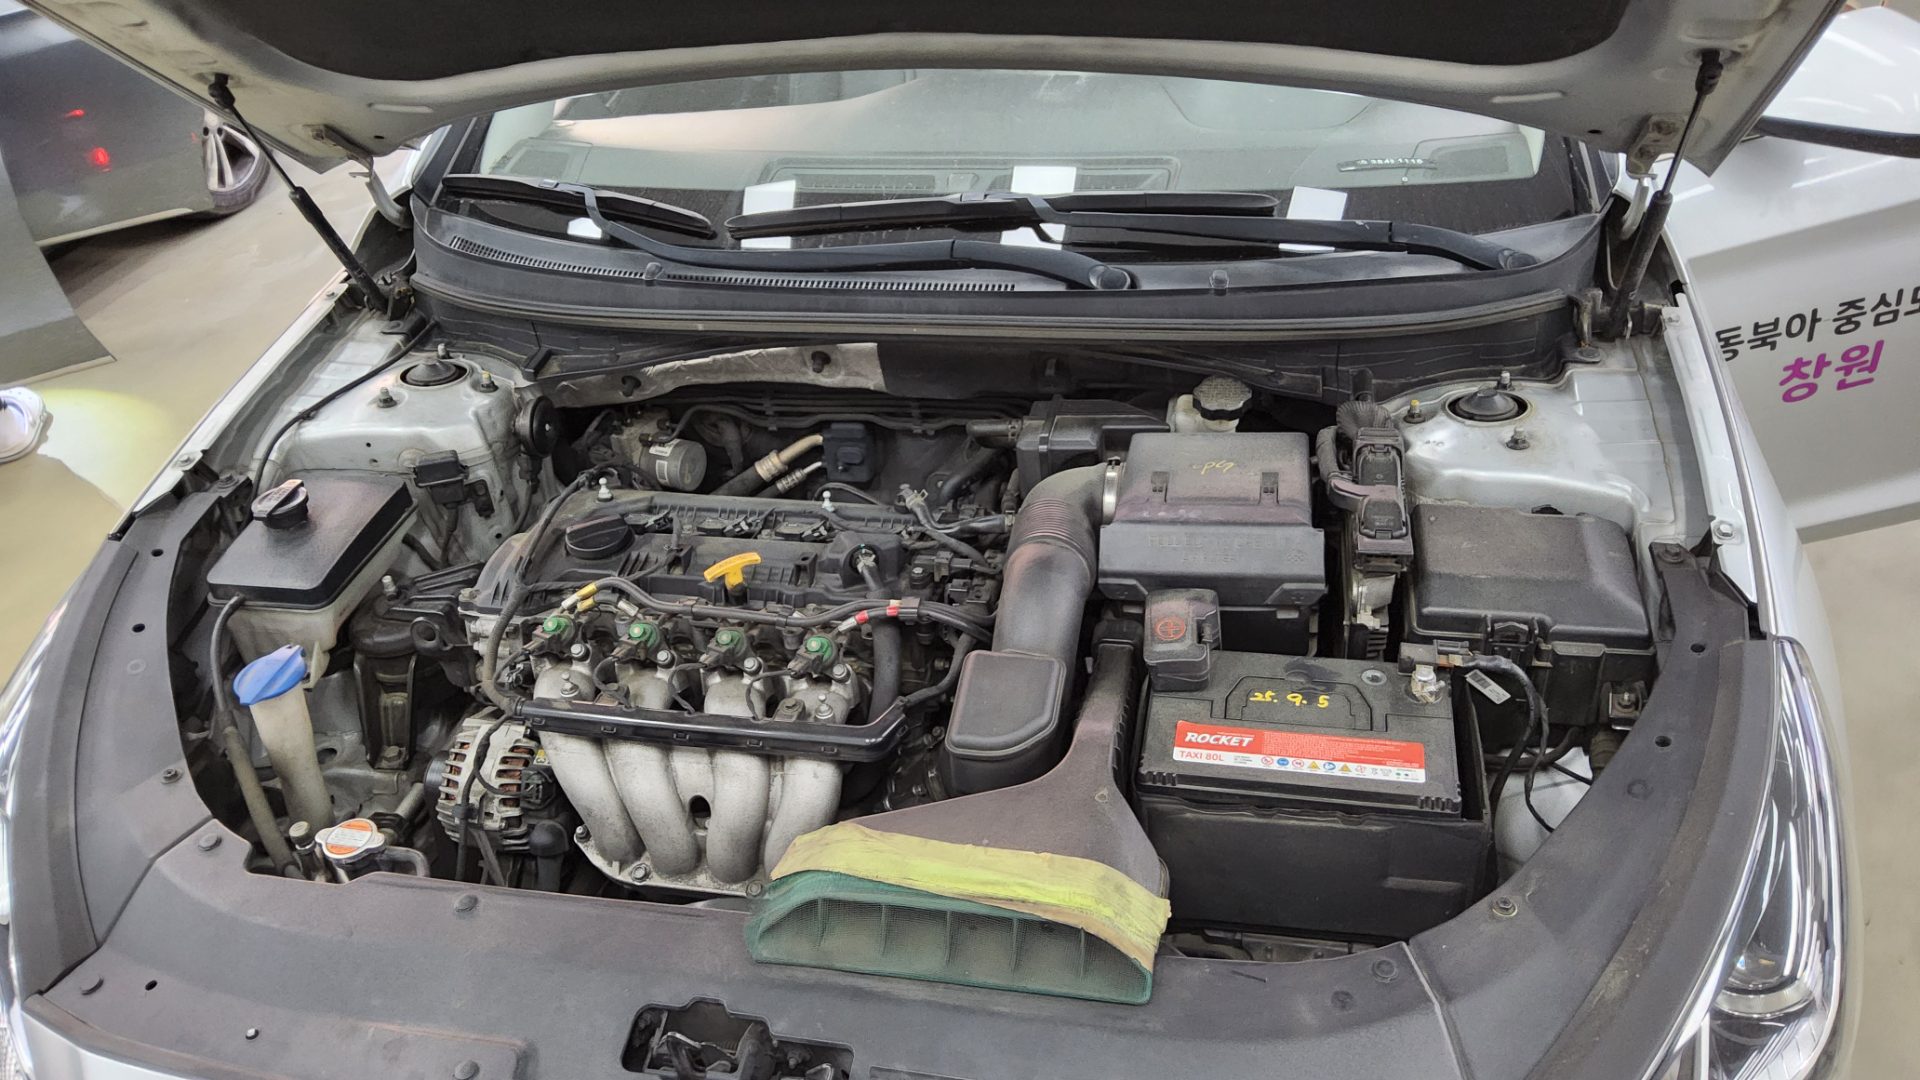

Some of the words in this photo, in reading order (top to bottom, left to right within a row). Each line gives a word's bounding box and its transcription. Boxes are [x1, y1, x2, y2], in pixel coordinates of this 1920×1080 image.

[1714, 308, 1822, 362] 동북아
[1779, 339, 1885, 403] 창원
[1317, 694, 1330, 708] 5
[1184, 731, 1254, 747] ROCKET
[1179, 750, 1204, 760] TAXI
[1205, 753, 1225, 762] 80L
